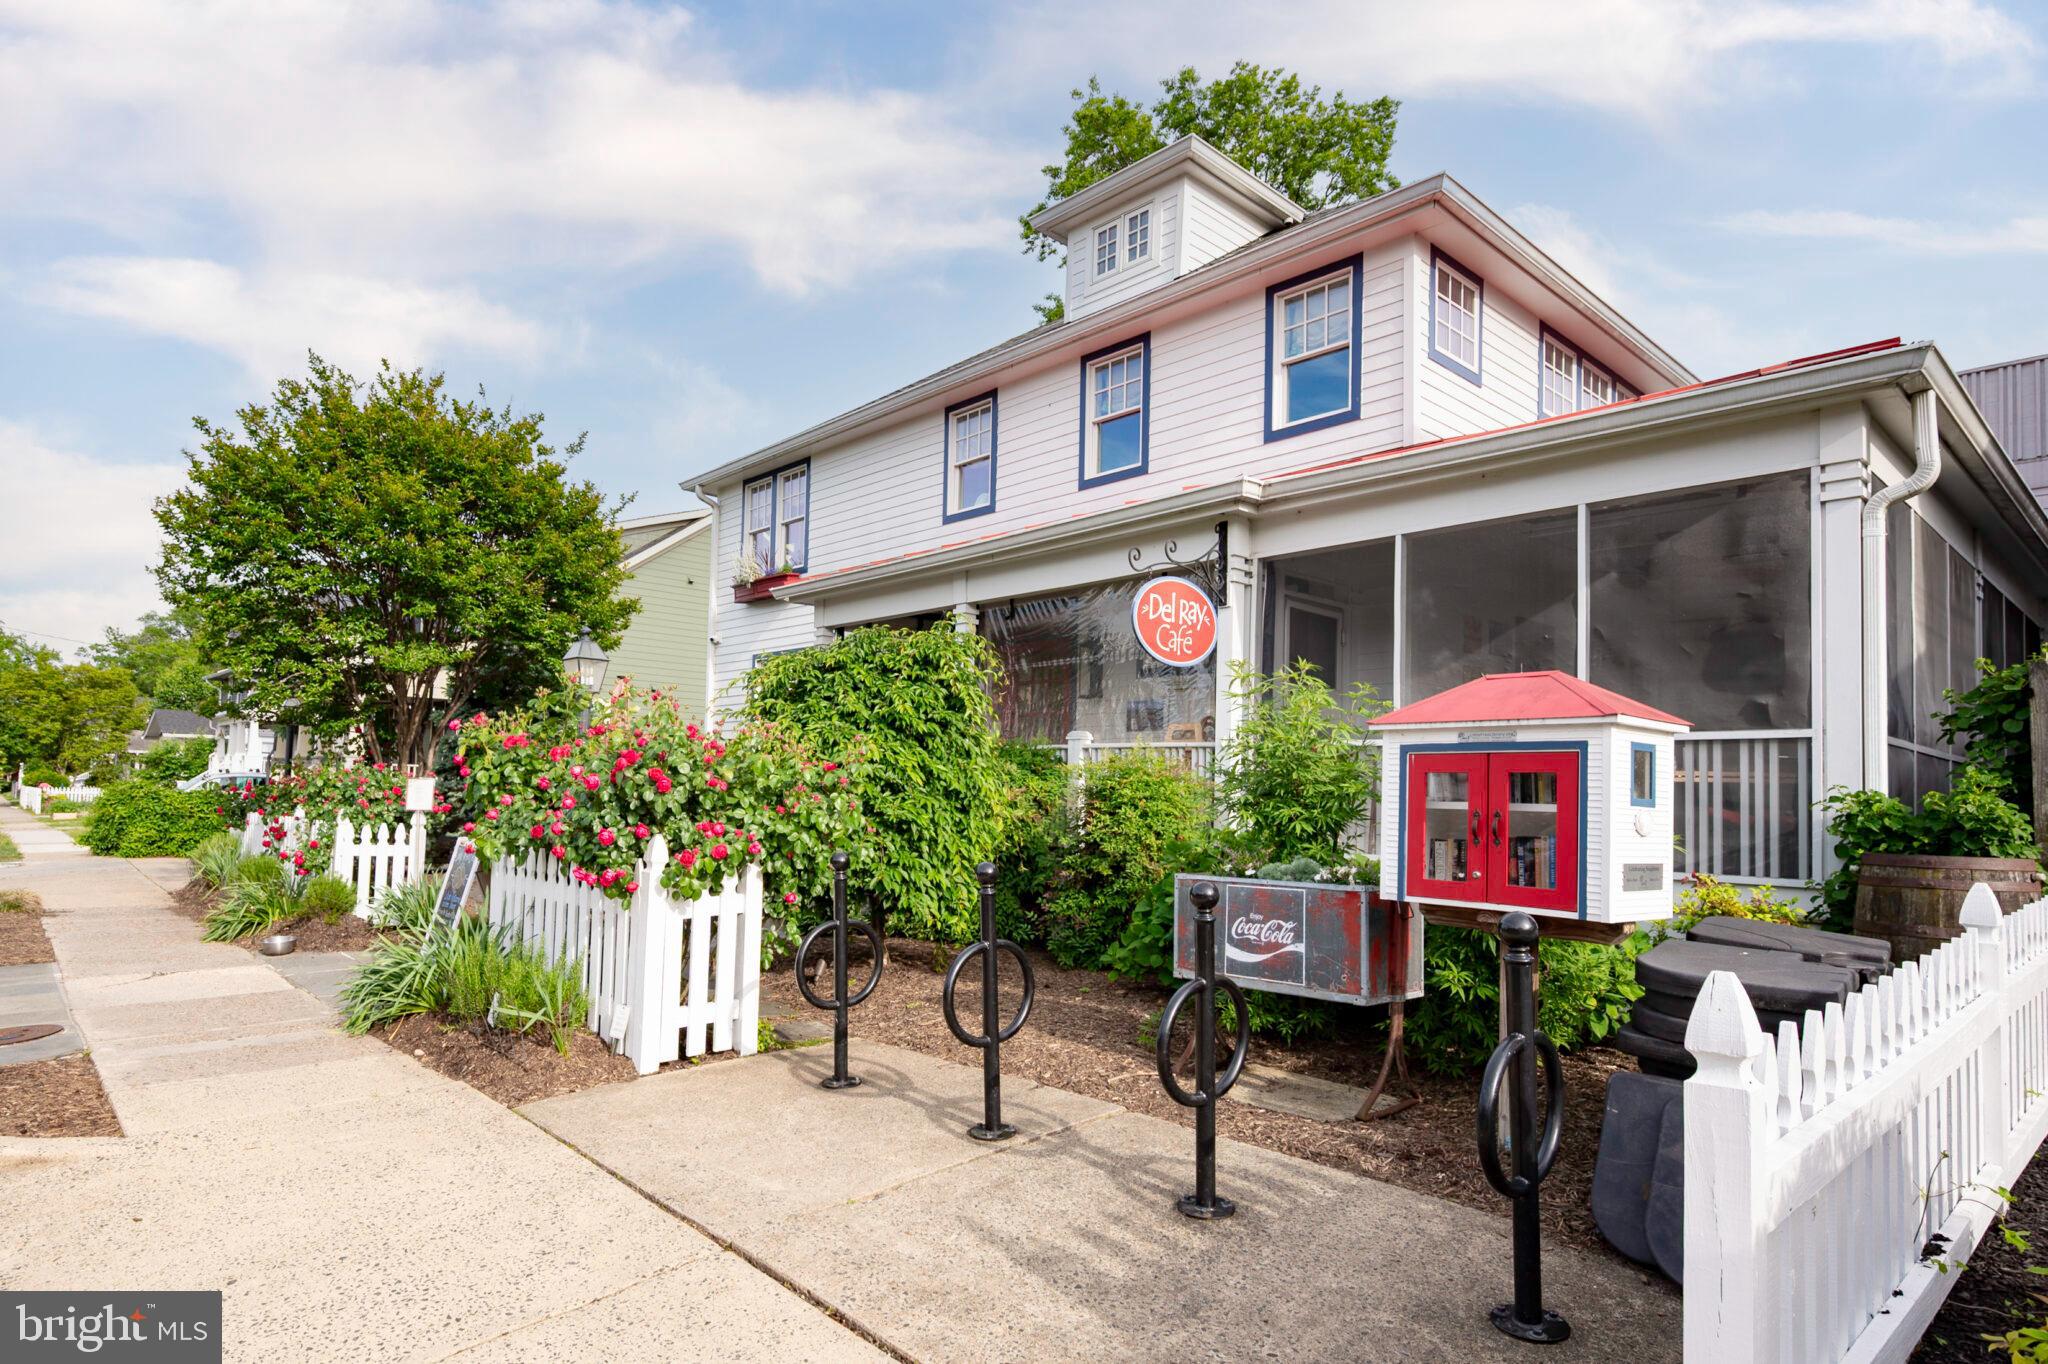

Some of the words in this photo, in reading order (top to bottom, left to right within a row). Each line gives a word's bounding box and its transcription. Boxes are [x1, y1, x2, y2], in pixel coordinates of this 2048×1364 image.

[1149, 592, 1176, 622] Del
[1179, 599, 1207, 631] Ray
[1156, 624, 1193, 655] Café
[1231, 917, 1297, 944] Coca-Cola
